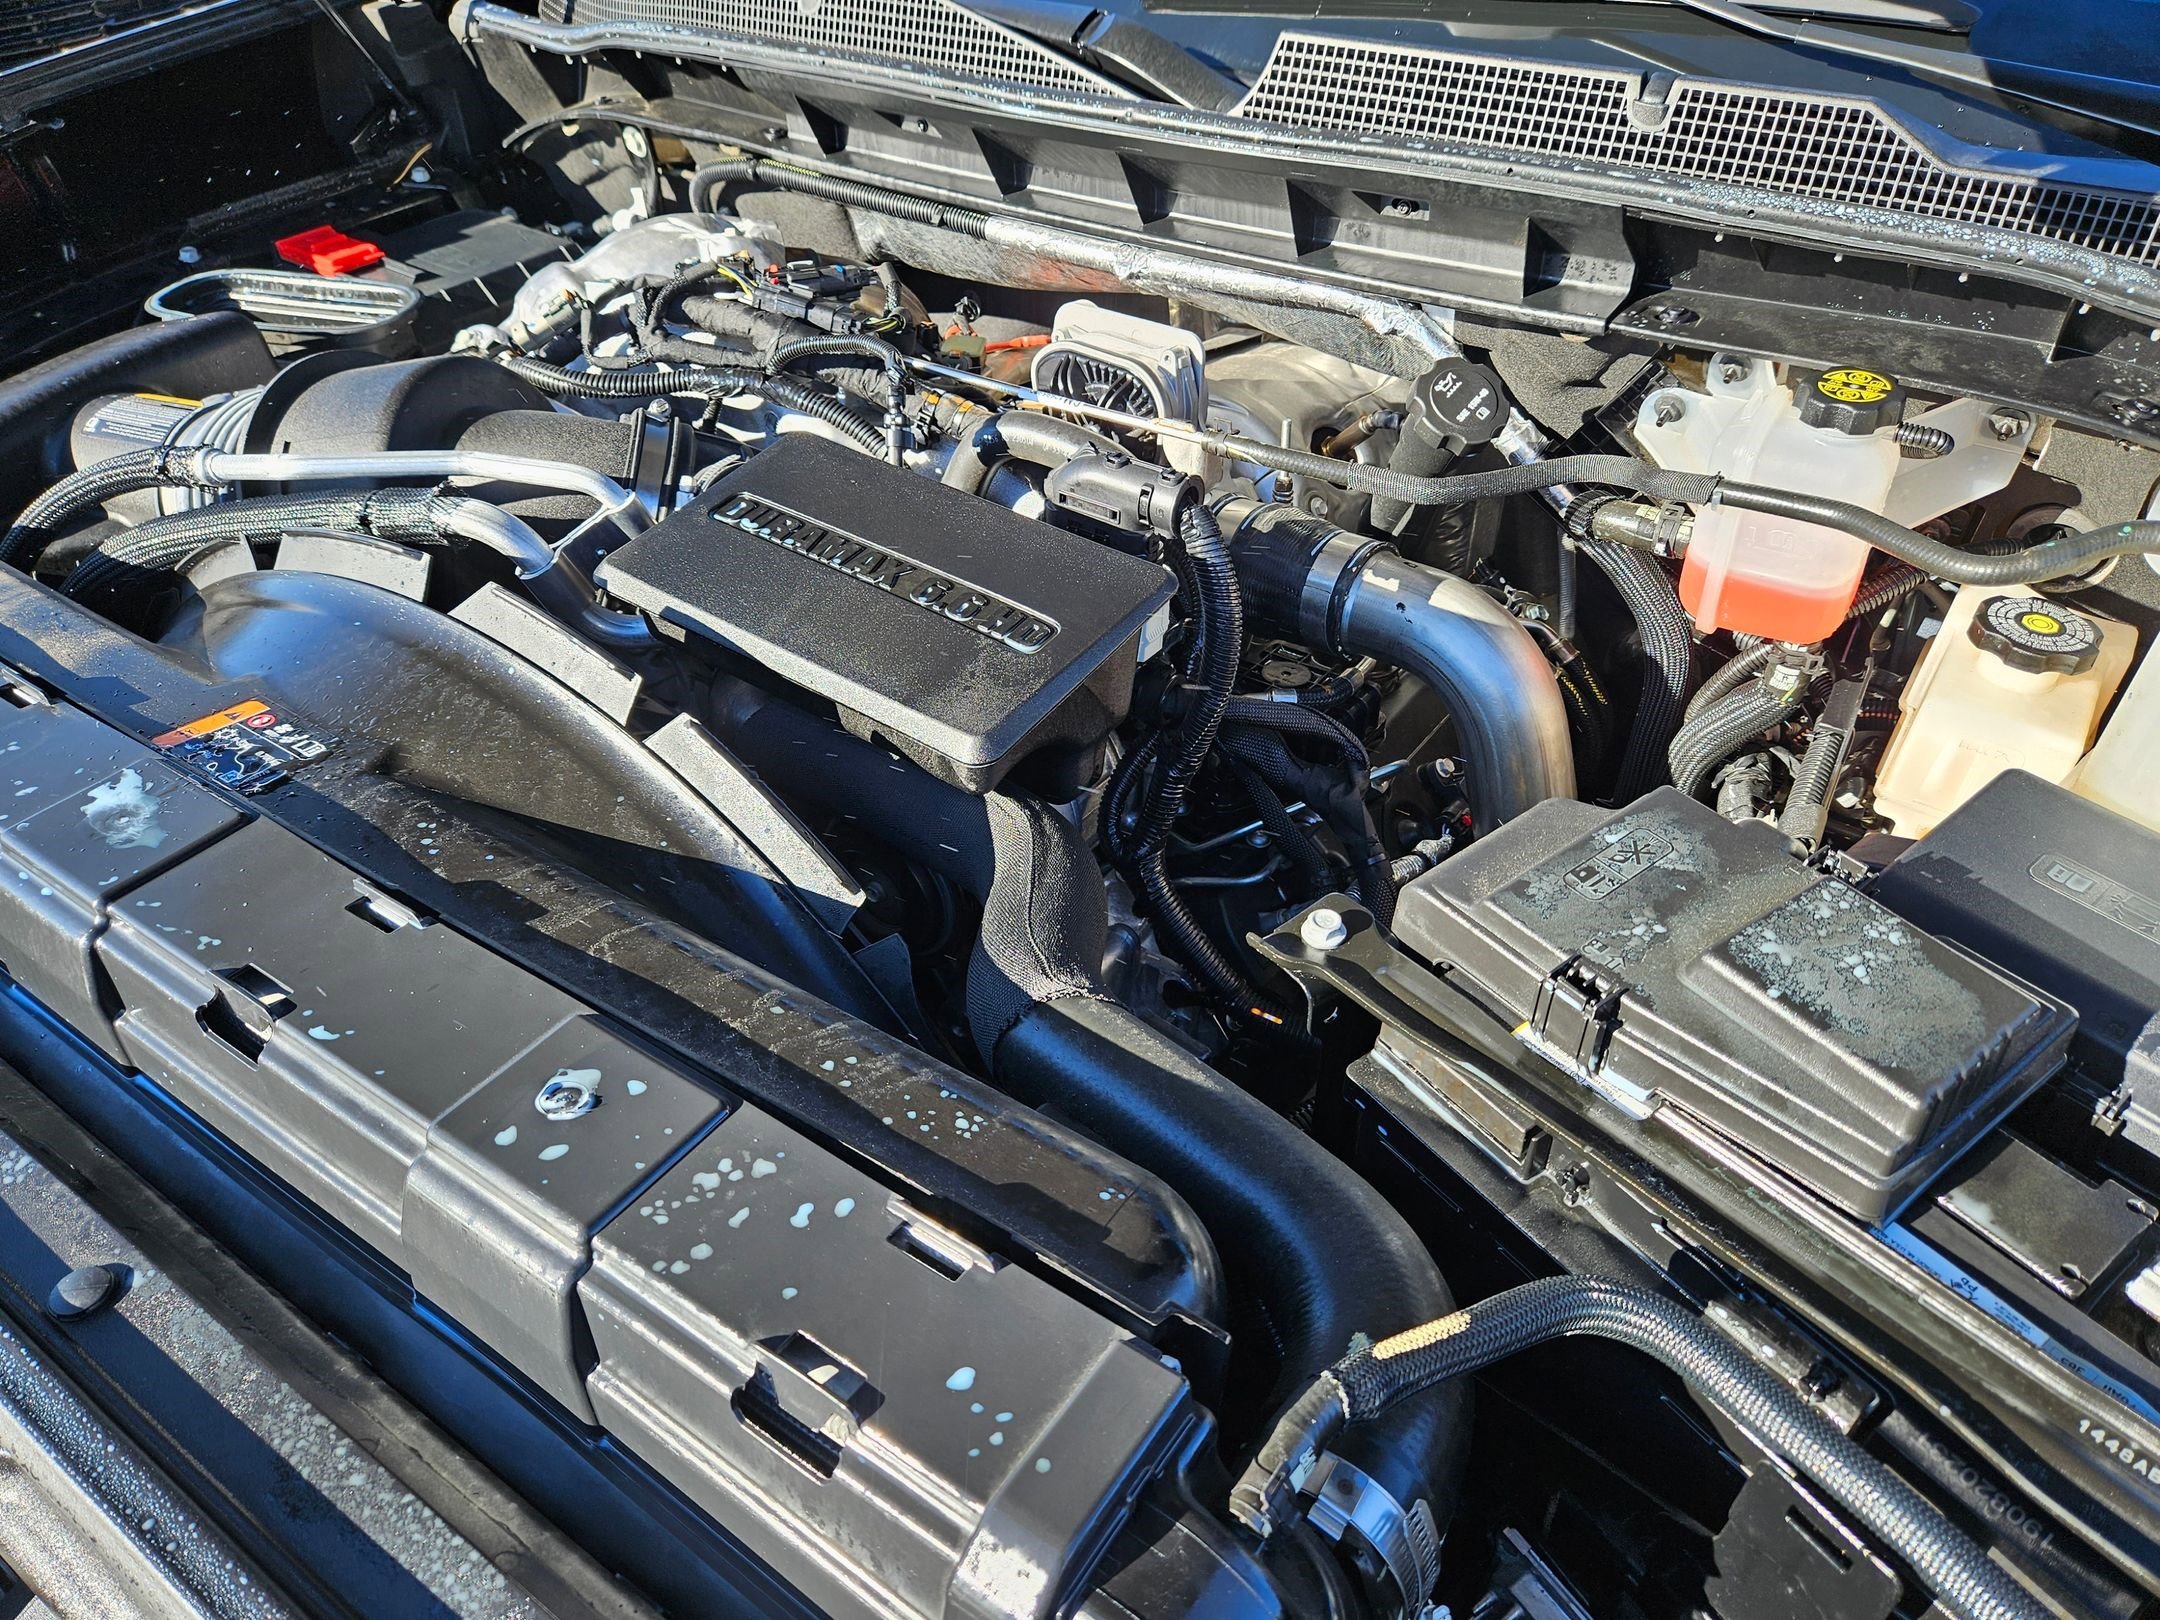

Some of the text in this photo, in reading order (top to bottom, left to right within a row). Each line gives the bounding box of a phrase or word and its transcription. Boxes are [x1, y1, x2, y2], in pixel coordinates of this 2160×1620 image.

[712, 497, 1057, 653] DURAMAX 6.6 HD
[1960, 1276, 1979, 1294] Pb
